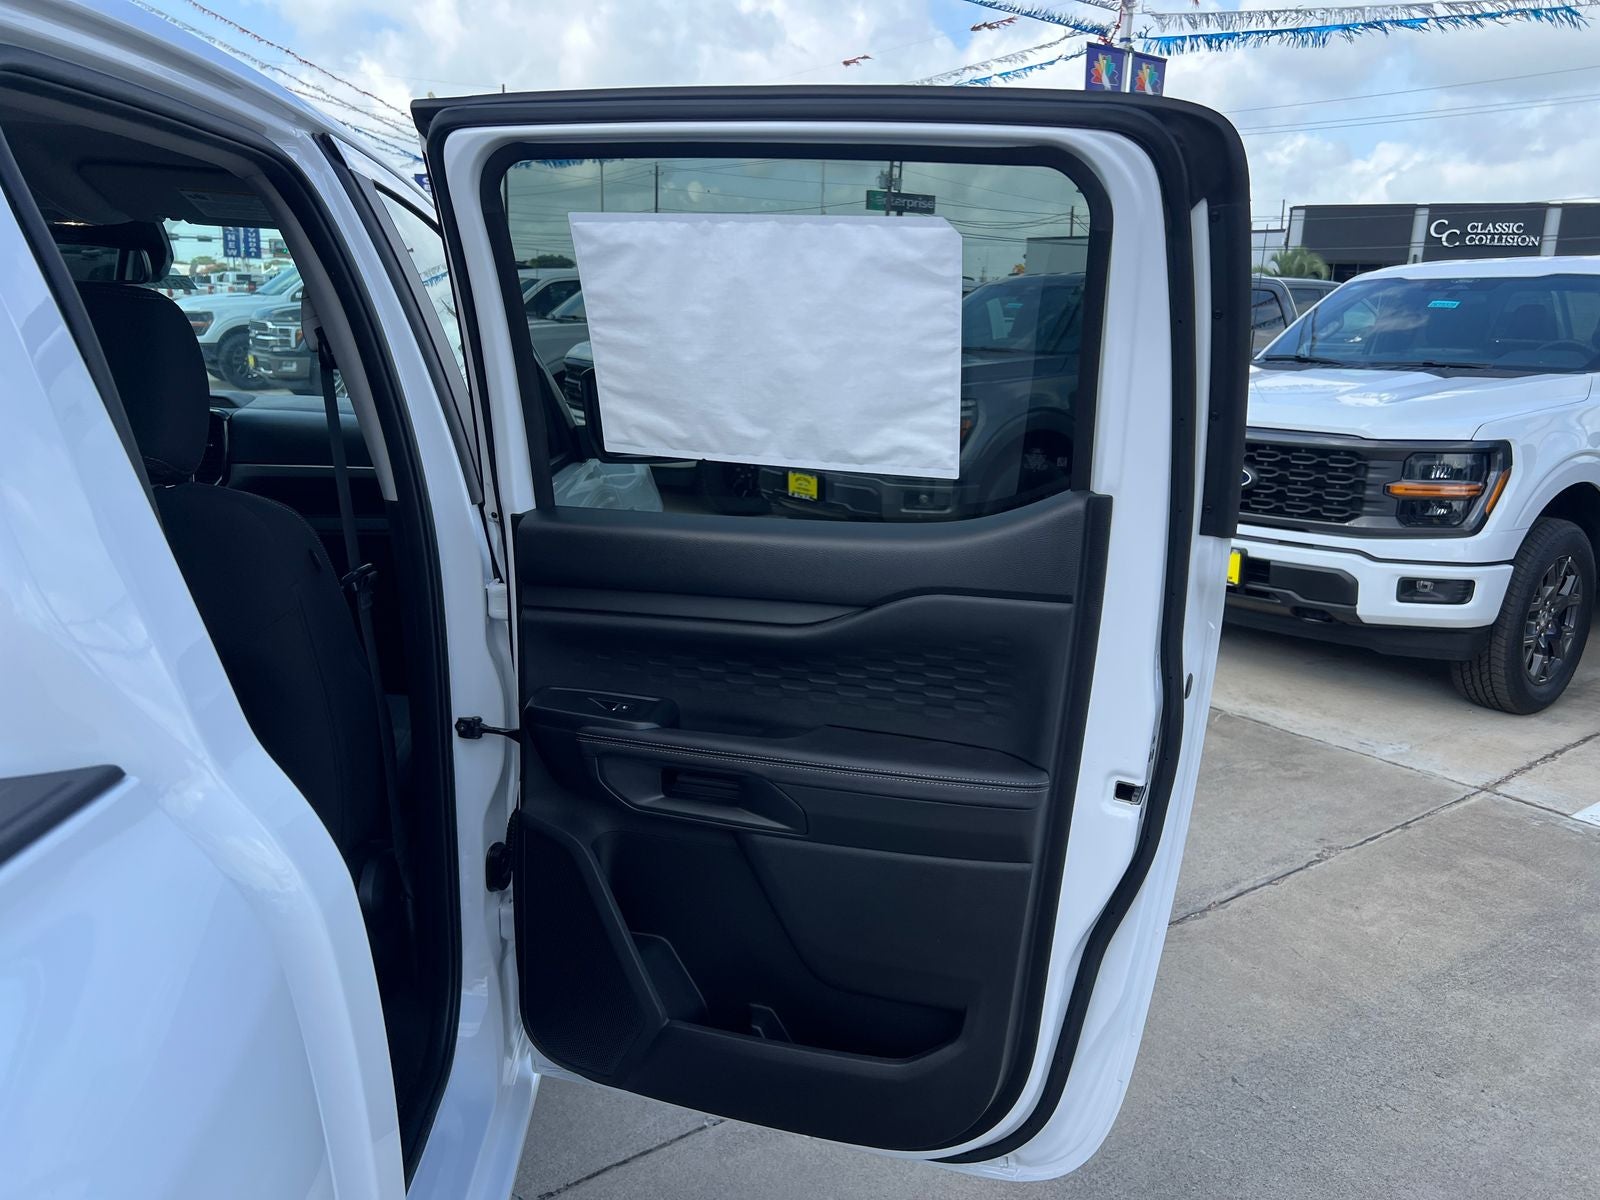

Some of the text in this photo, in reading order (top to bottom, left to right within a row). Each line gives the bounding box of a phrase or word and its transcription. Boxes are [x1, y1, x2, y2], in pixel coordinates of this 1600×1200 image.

[1467, 222, 1524, 234] CLASSIC
[226, 234, 238, 256] NEW
[1465, 235, 1540, 247] COLLISION
